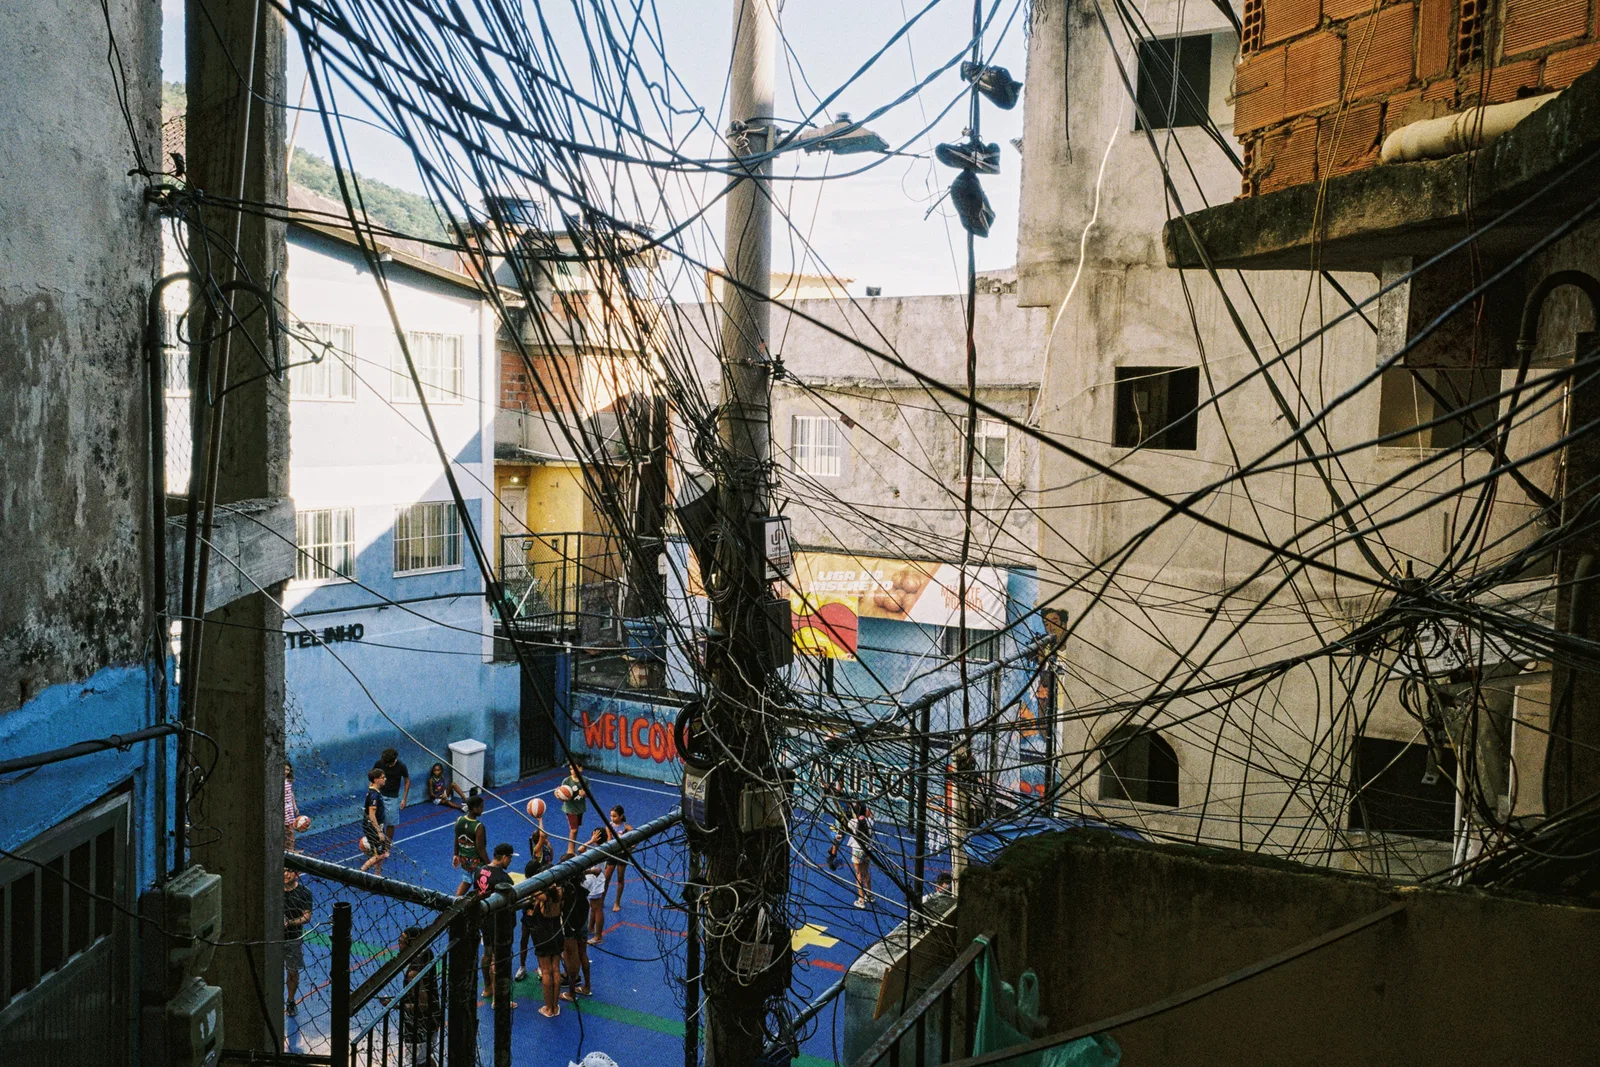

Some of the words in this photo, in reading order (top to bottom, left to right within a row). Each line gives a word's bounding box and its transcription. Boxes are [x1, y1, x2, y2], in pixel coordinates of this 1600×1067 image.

[817, 571, 856, 581] LIGA
[860, 570, 883, 581] DO
[284, 623, 364, 649] TELINHO
